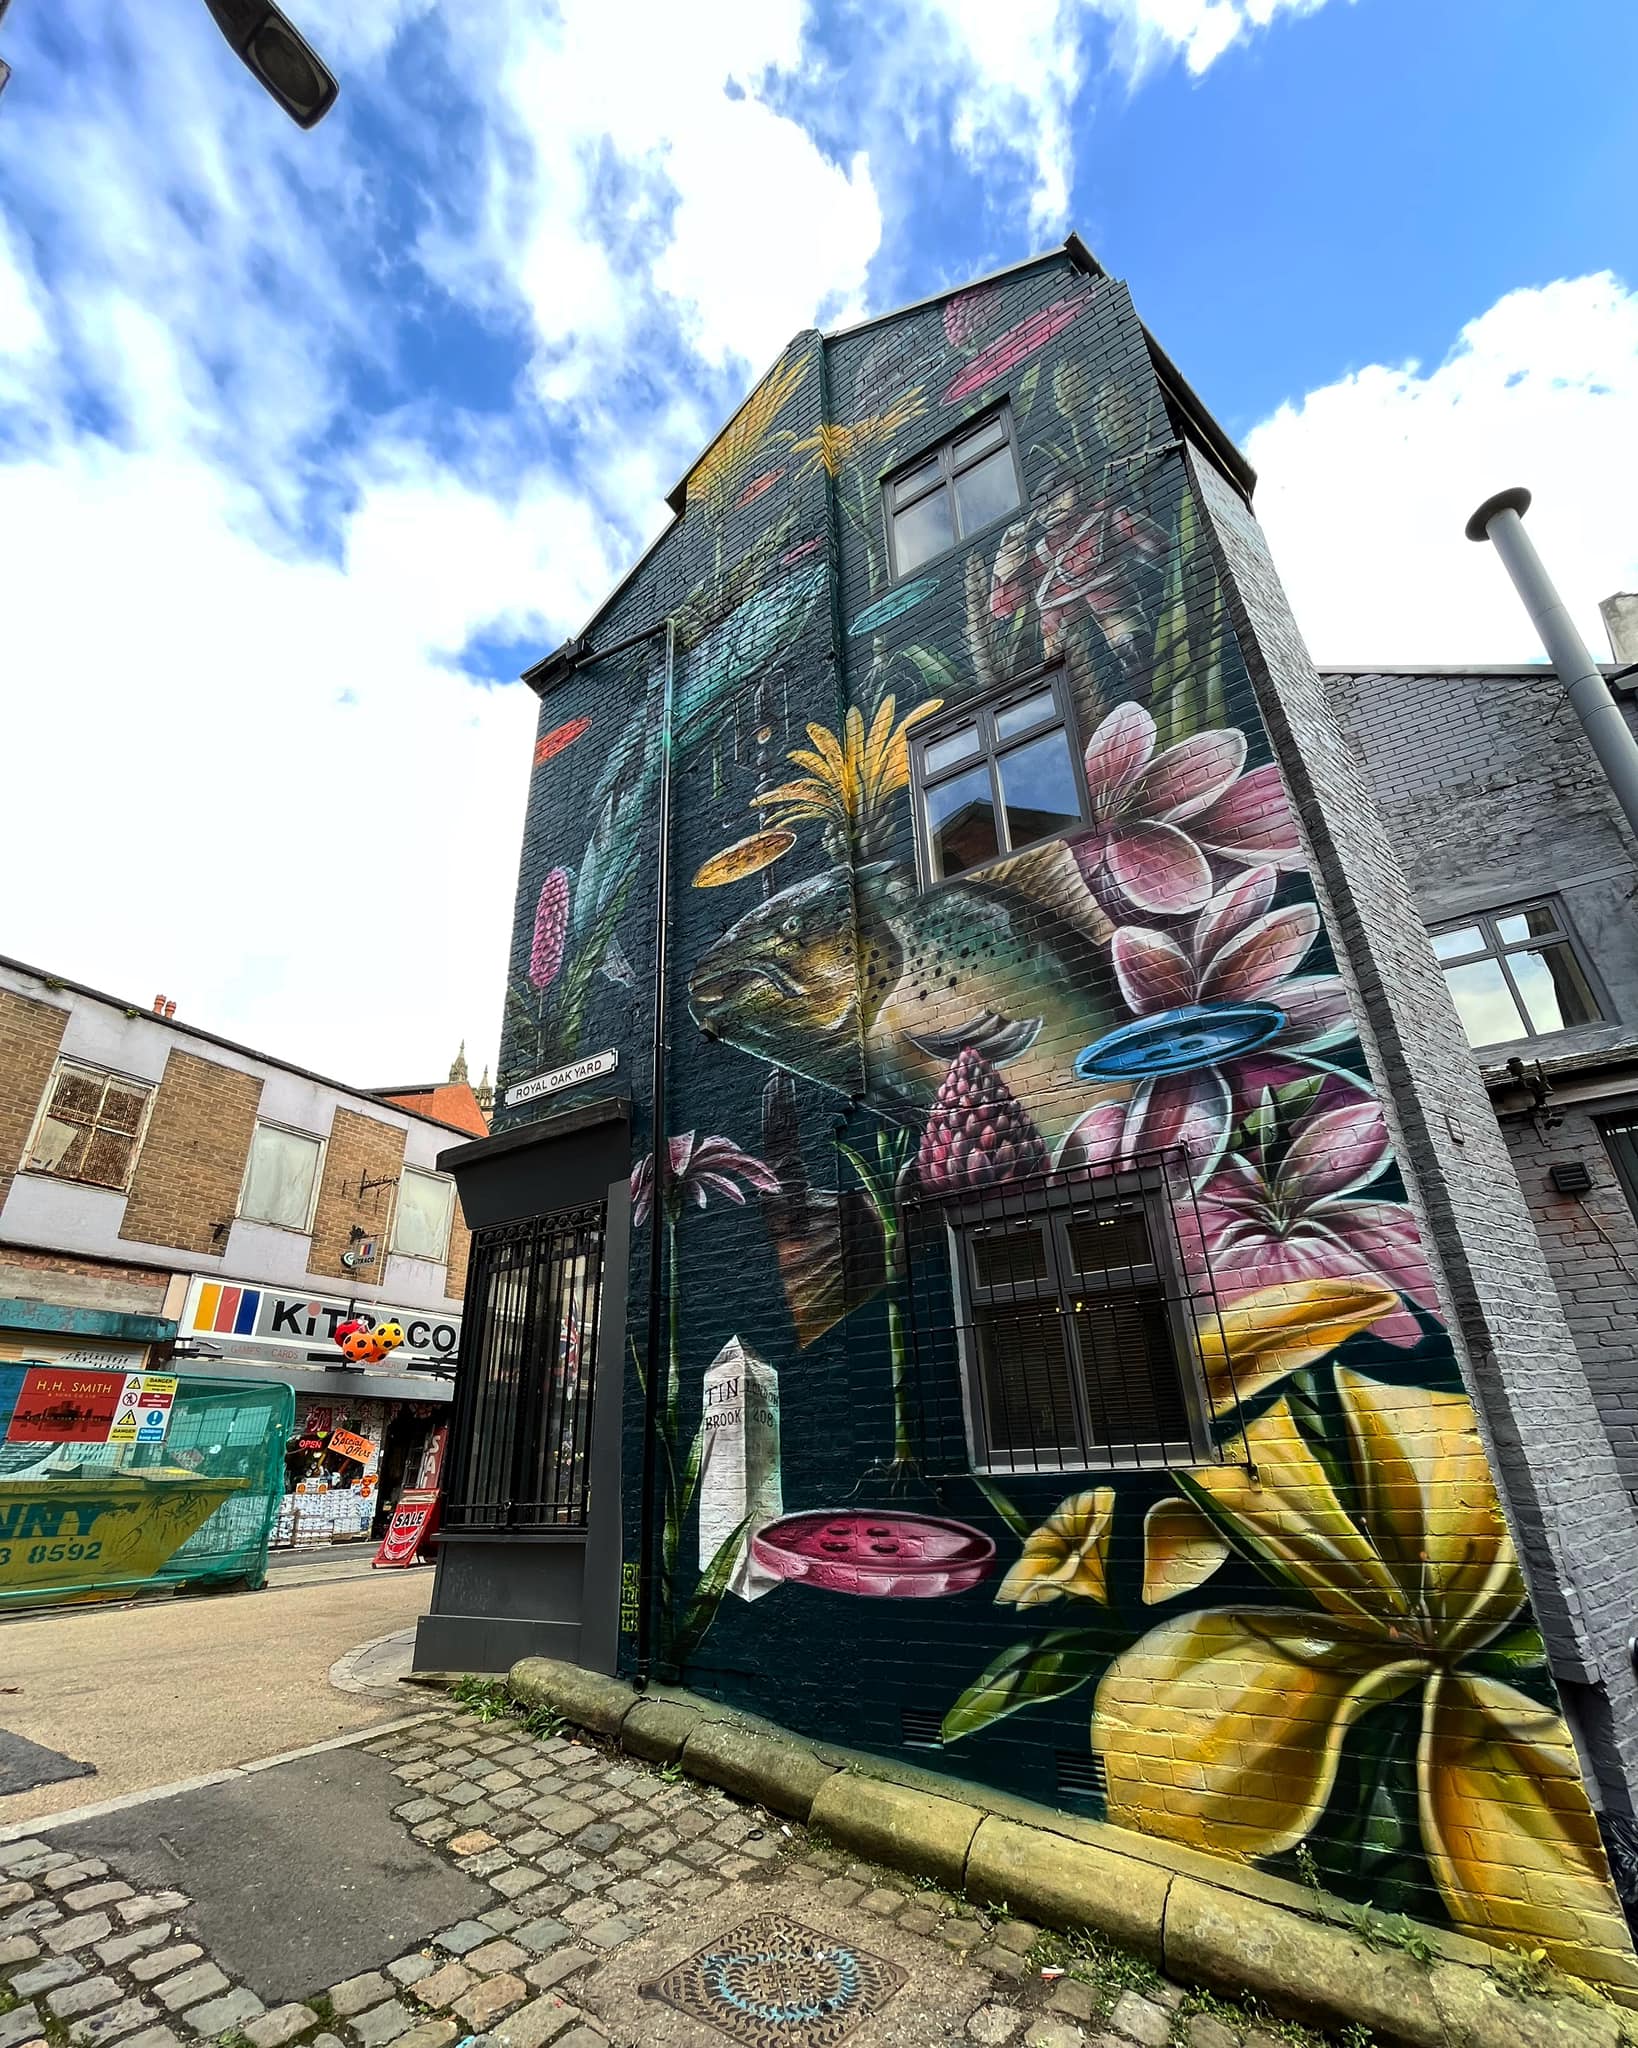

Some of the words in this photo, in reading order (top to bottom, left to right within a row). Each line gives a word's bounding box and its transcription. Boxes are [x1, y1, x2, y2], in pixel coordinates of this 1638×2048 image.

[515, 1081, 548, 1099] ROYAL
[550, 1070, 572, 1086] OAK
[574, 1060, 602, 1077] YARD
[271, 1348, 298, 1360] CARDS
[71, 1382, 113, 1394] SMITH
[704, 1376, 741, 1406] TIN
[705, 1408, 742, 1431] BROOK
[753, 1406, 774, 1428] 208
[299, 1439, 322, 1449] OPEN
[332, 1431, 363, 1447] Special
[394, 1510, 425, 1528] SALE
[27, 1541, 102, 1565] 8592
